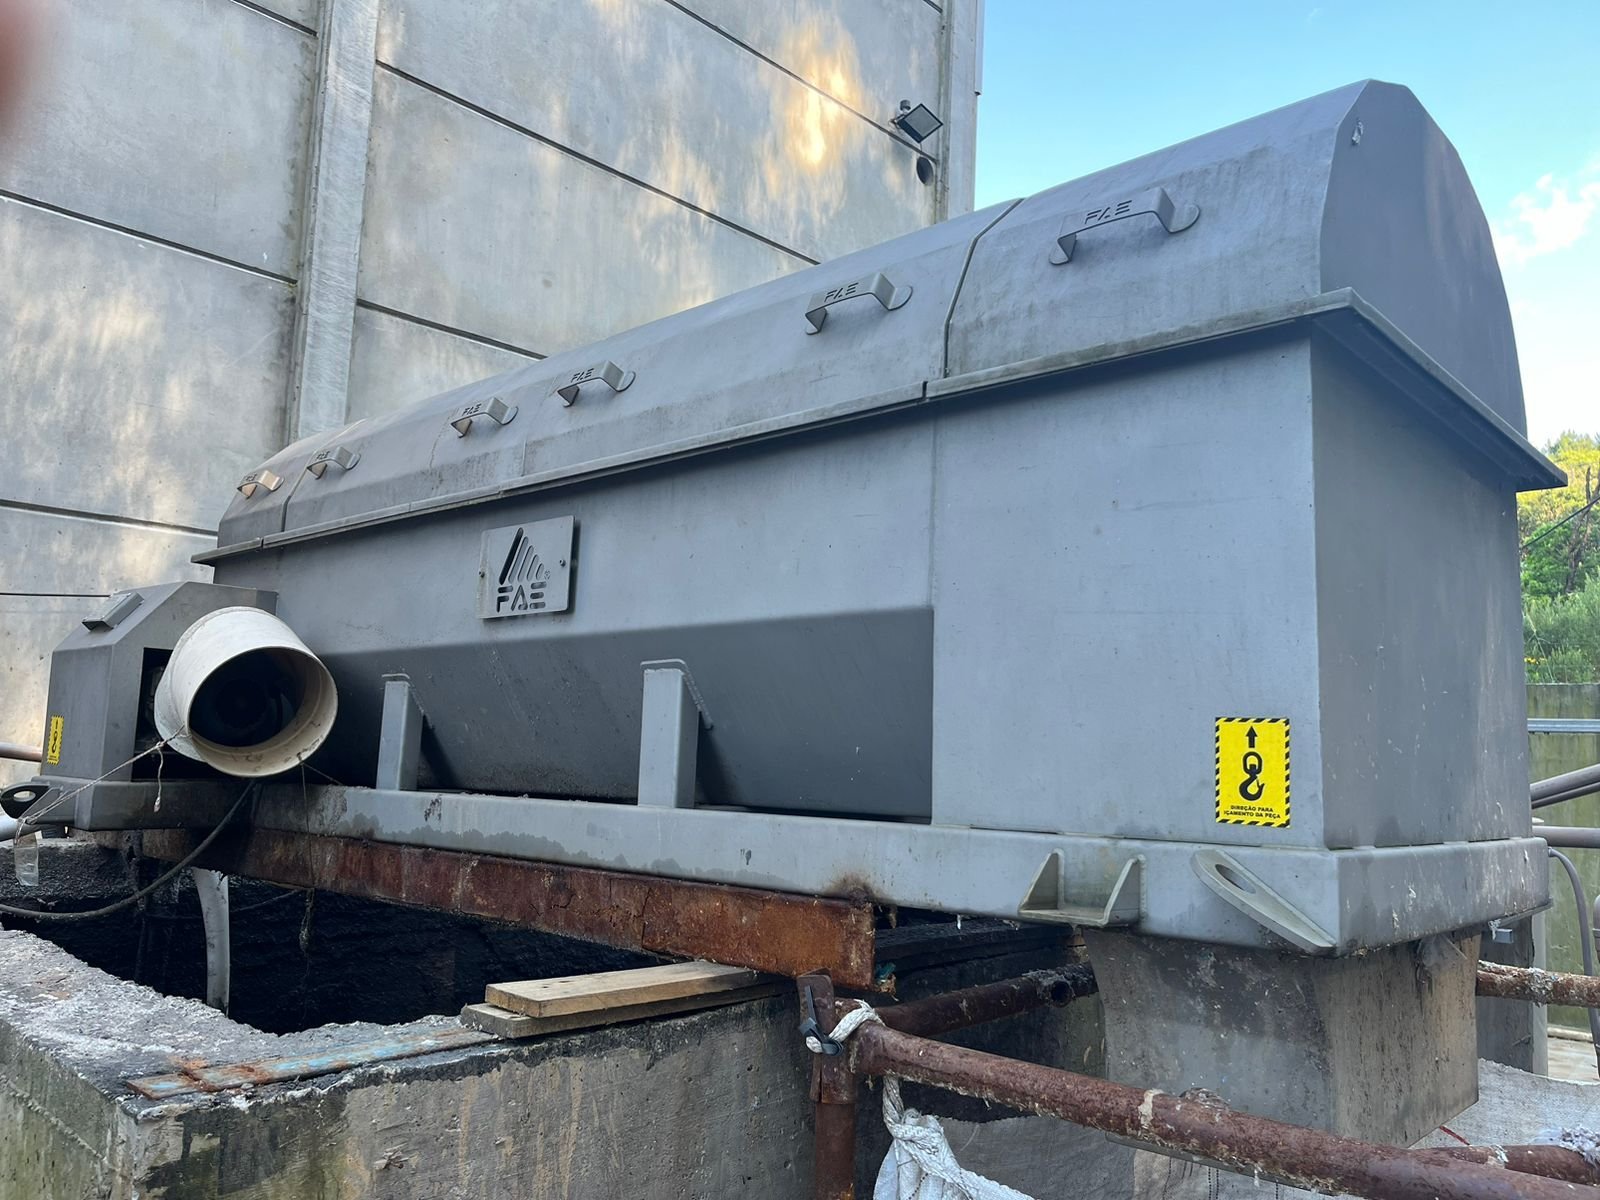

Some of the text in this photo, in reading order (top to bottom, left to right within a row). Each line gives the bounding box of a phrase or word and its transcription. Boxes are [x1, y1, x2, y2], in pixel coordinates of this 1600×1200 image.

[1084, 199, 1133, 225] FAE
[823, 282, 859, 303] FAE
[496, 581, 548, 613] FAE
